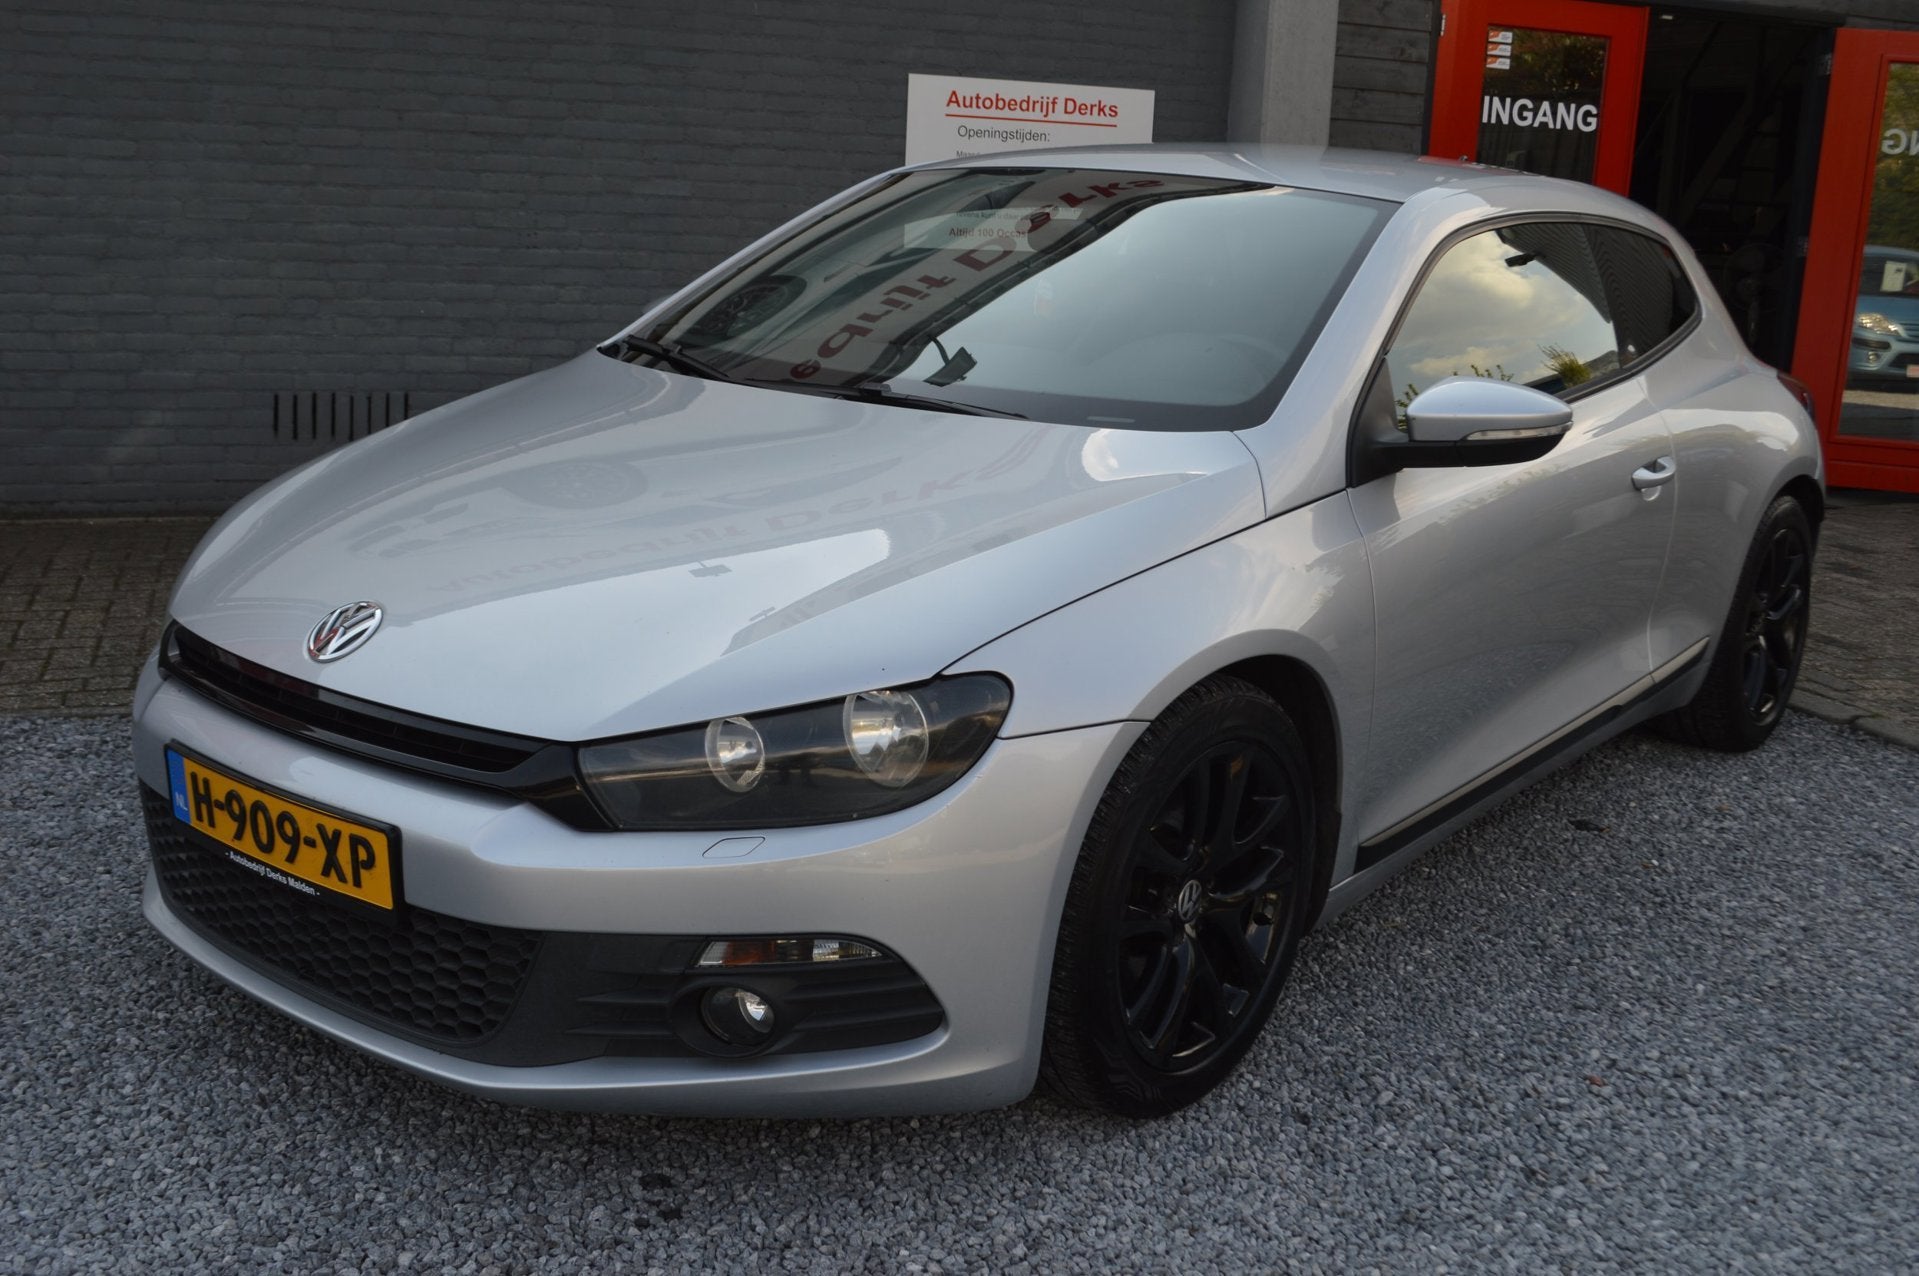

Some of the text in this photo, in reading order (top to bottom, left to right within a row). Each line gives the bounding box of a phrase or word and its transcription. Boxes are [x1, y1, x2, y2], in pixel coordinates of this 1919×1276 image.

[946, 90, 1118, 118] Autobedrijf Derks
[1482, 96, 1598, 132] INGANG
[957, 125, 1050, 142] Openingstijden:
[175, 791, 188, 811] NL
[190, 772, 376, 888] H-909-XP
